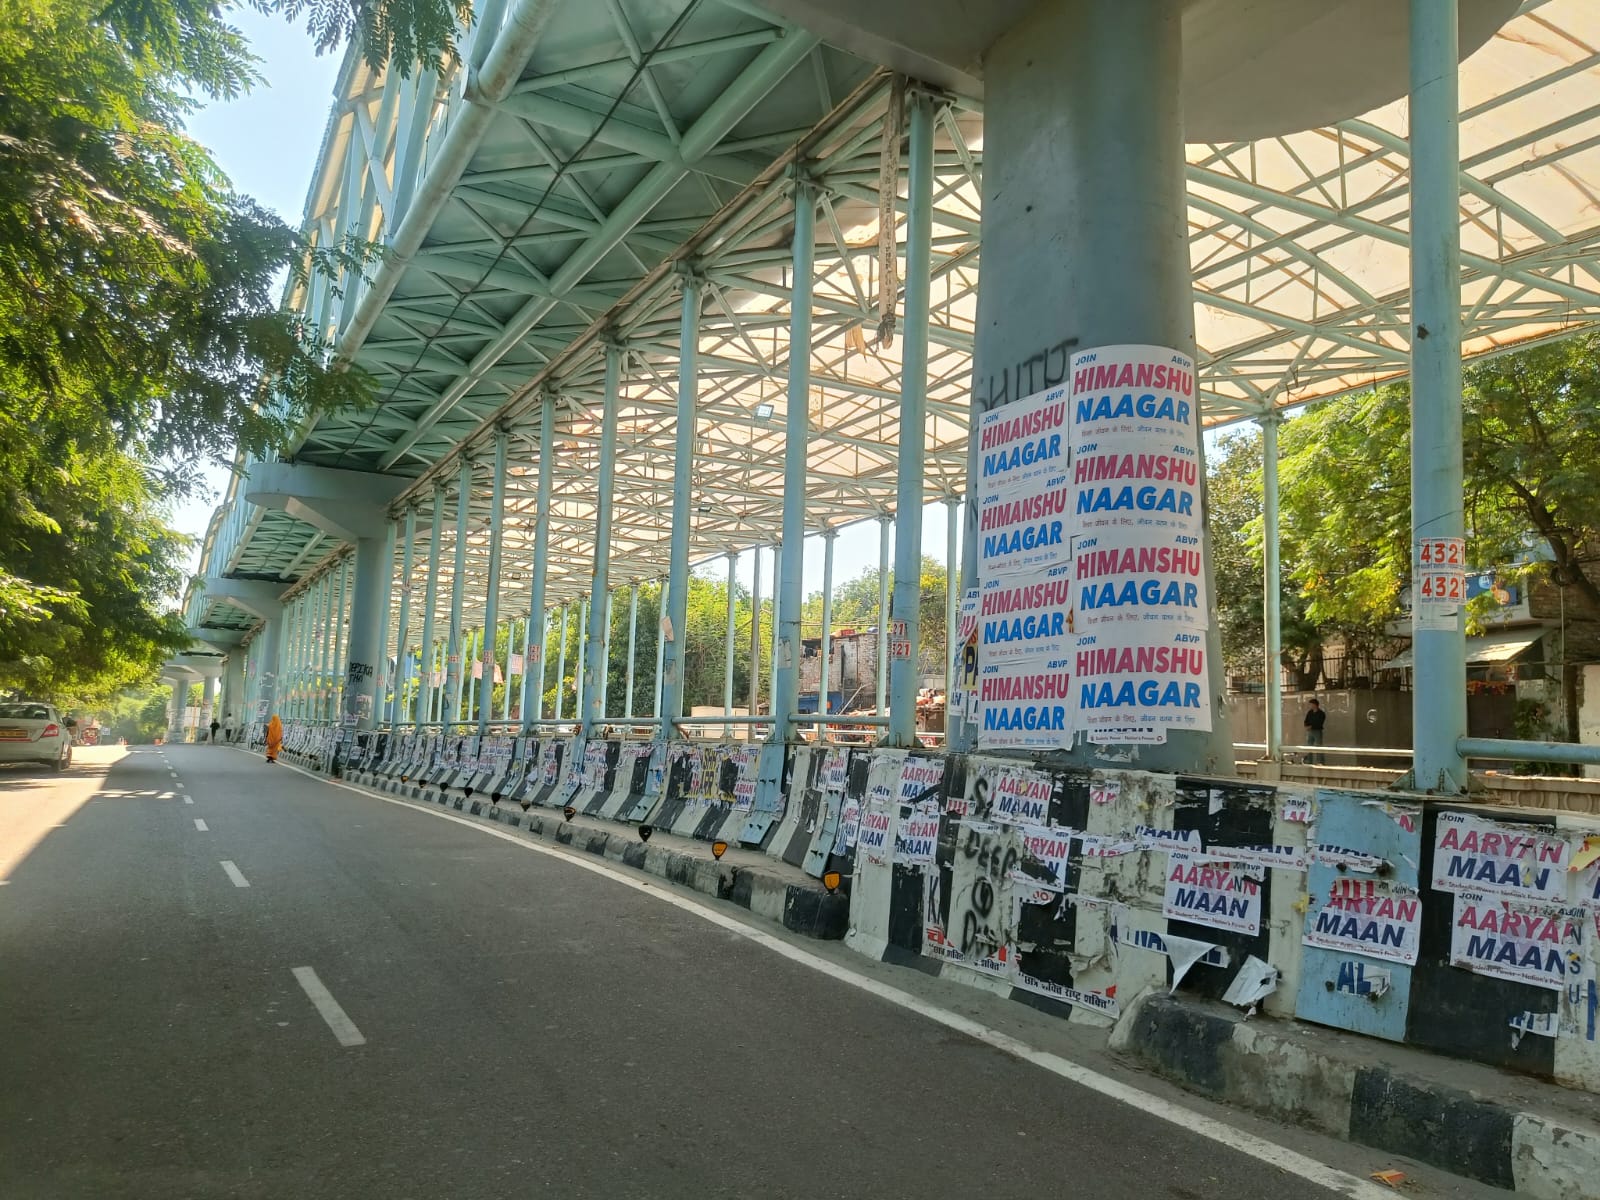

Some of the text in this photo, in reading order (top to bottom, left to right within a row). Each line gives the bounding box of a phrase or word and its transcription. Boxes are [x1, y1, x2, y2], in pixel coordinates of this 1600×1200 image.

[1075, 354, 1191, 368] JOIN ABVP
[1073, 363, 1193, 396] HIMANSHU
[983, 389, 1064, 424] JOIN ABVP
[1076, 394, 1190, 425] NAAGAR
[981, 401, 1066, 452] HIMANSHU
[983, 434, 1061, 478] NAAGAR
[1076, 443, 1195, 456] JOIN ABVP
[1074, 454, 1196, 486] HIMANSHU
[983, 475, 1066, 505] JOIN ABVP
[1076, 486, 1192, 516] NAAGAR
[980, 487, 1067, 532] HIMANSHU
[983, 520, 1062, 559] NAAGAR
[1077, 534, 1198, 550] JOIN ABVP
[983, 566, 1068, 590] JOIN ABVP
[1076, 547, 1200, 580] HIMANSHU
[981, 579, 1069, 617] HIMANSHU
[1080, 580, 1198, 611] NAAGAR
[983, 612, 1064, 644] NAAGAR
[1076, 633, 1200, 646] JOIN ABVP
[983, 660, 1068, 674] JOIN ABVP
[1076, 646, 1203, 677] HIMANSHU
[981, 673, 1070, 701] HIMANSHU
[1080, 680, 1201, 709] NAAGAR
[984, 706, 1064, 731] NAAGAR
[901, 766, 944, 784] AARYAN
[999, 796, 1043, 819] MAAN
[1441, 813, 1465, 823] JOIN
[1171, 852, 1189, 860] JOIN
[1440, 827, 1564, 864] AARYAN
[1174, 887, 1249, 919] MAAN
[1459, 892, 1483, 901] JOIN
[1316, 912, 1405, 947] MAAN
